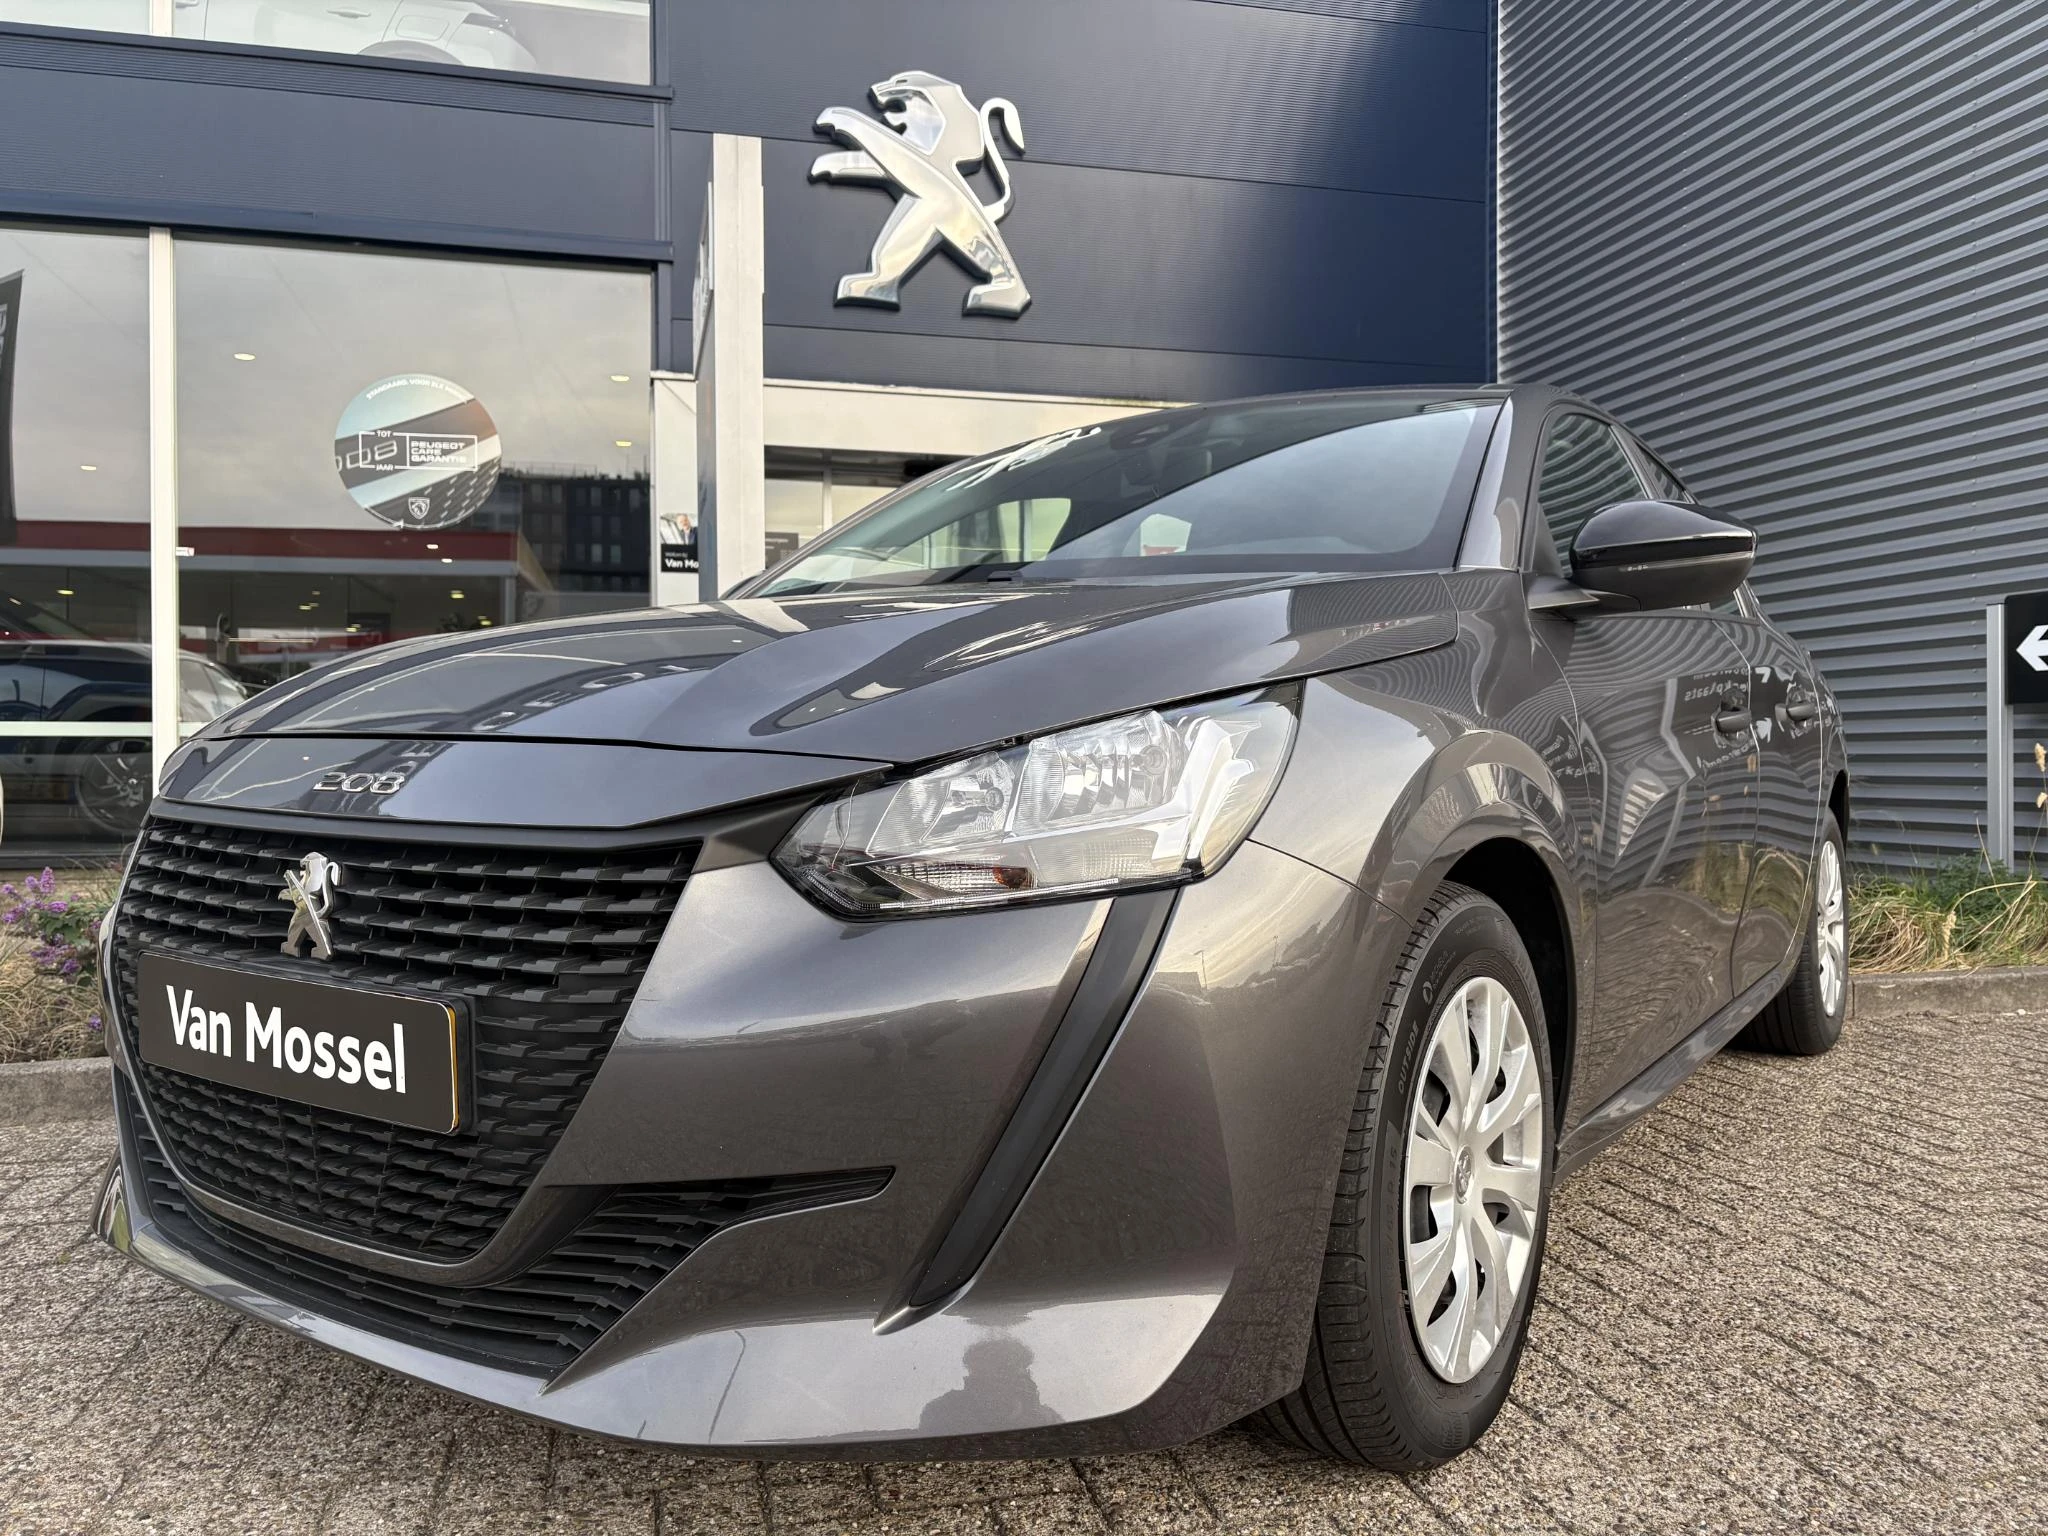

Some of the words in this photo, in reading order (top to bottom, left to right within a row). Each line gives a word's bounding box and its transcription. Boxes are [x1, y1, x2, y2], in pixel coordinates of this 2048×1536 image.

[411, 441, 466, 449] PEUGEOT
[411, 448, 442, 456] CARE
[411, 454, 467, 463] GARANTIE
[665, 558, 683, 568] Van
[313, 772, 405, 794] 208
[166, 985, 232, 1058] Van
[245, 1001, 406, 1094] Mossel
[1398, 1019, 1419, 1095] OUTSIDE
